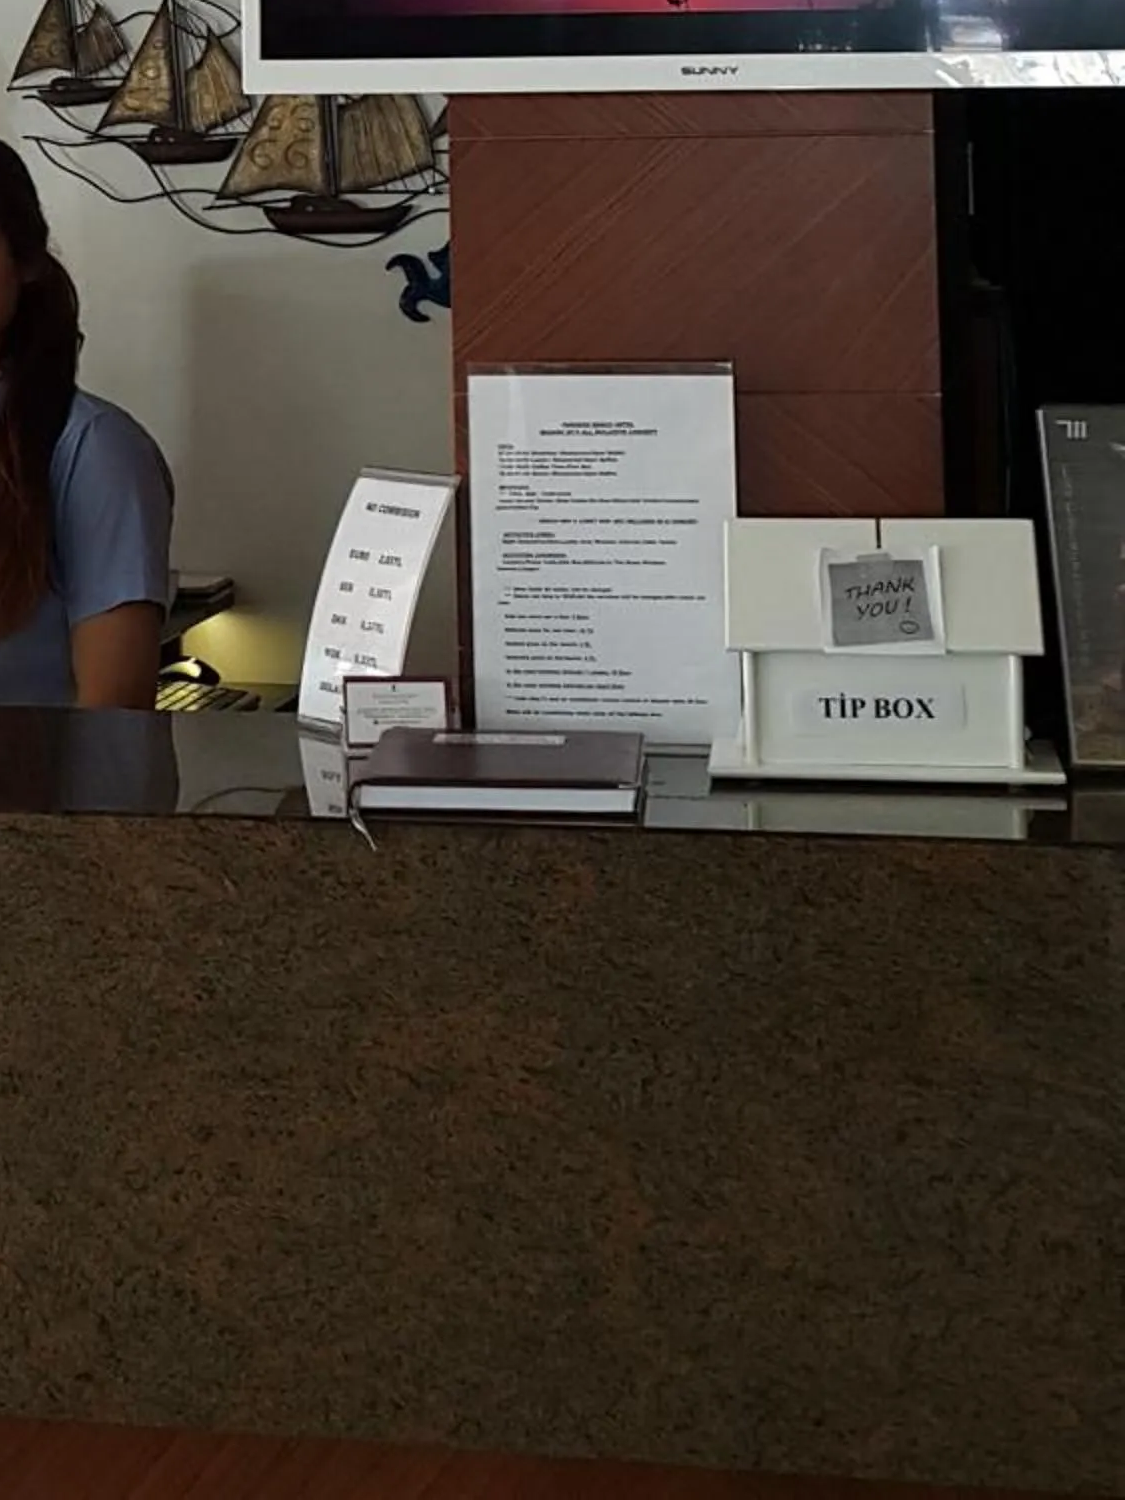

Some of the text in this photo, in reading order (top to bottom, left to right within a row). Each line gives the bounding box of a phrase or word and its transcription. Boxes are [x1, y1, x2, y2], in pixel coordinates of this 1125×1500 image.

[680, 66, 740, 76] SUNNY
[844, 576, 916, 600] THANK
[818, 692, 936, 719] TİP BOX
